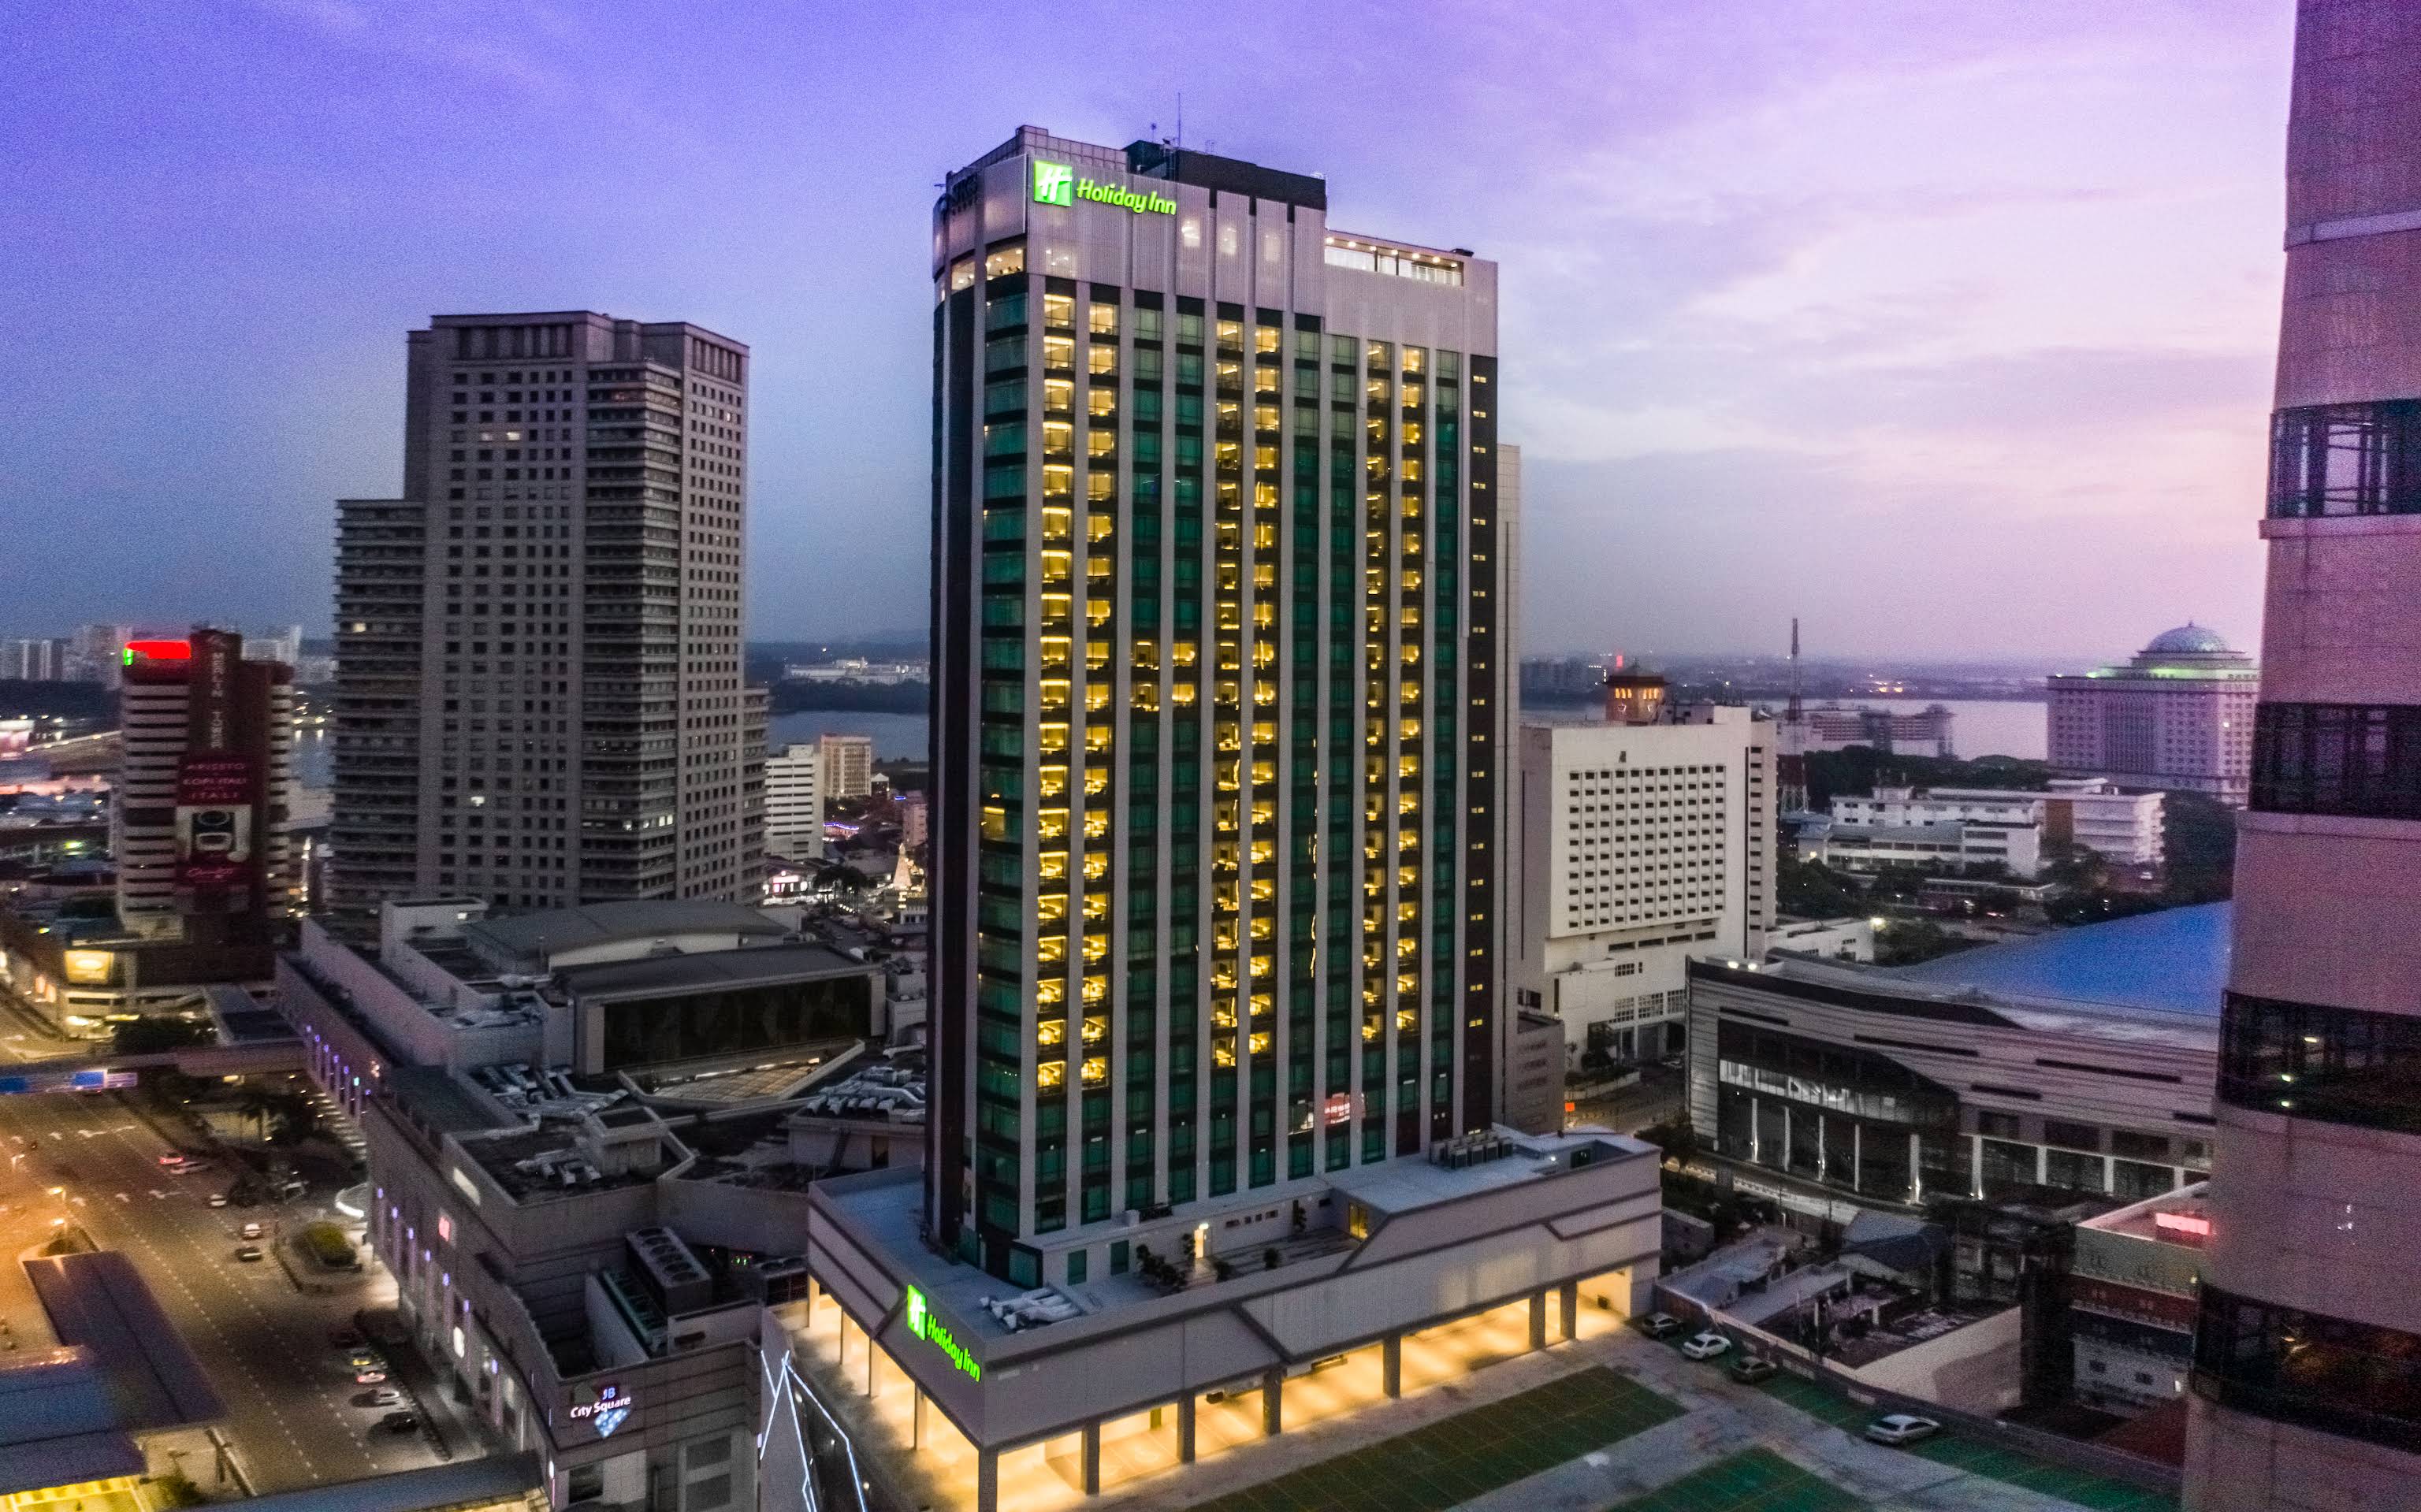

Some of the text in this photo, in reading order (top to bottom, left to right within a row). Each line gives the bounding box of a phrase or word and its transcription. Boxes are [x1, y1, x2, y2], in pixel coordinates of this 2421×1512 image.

[1077, 178, 1177, 215] Holiday Inn
[927, 1313, 981, 1382] Holiday Inn
[570, 1397, 631, 1418] City Square
[602, 1387, 615, 1400] JB
